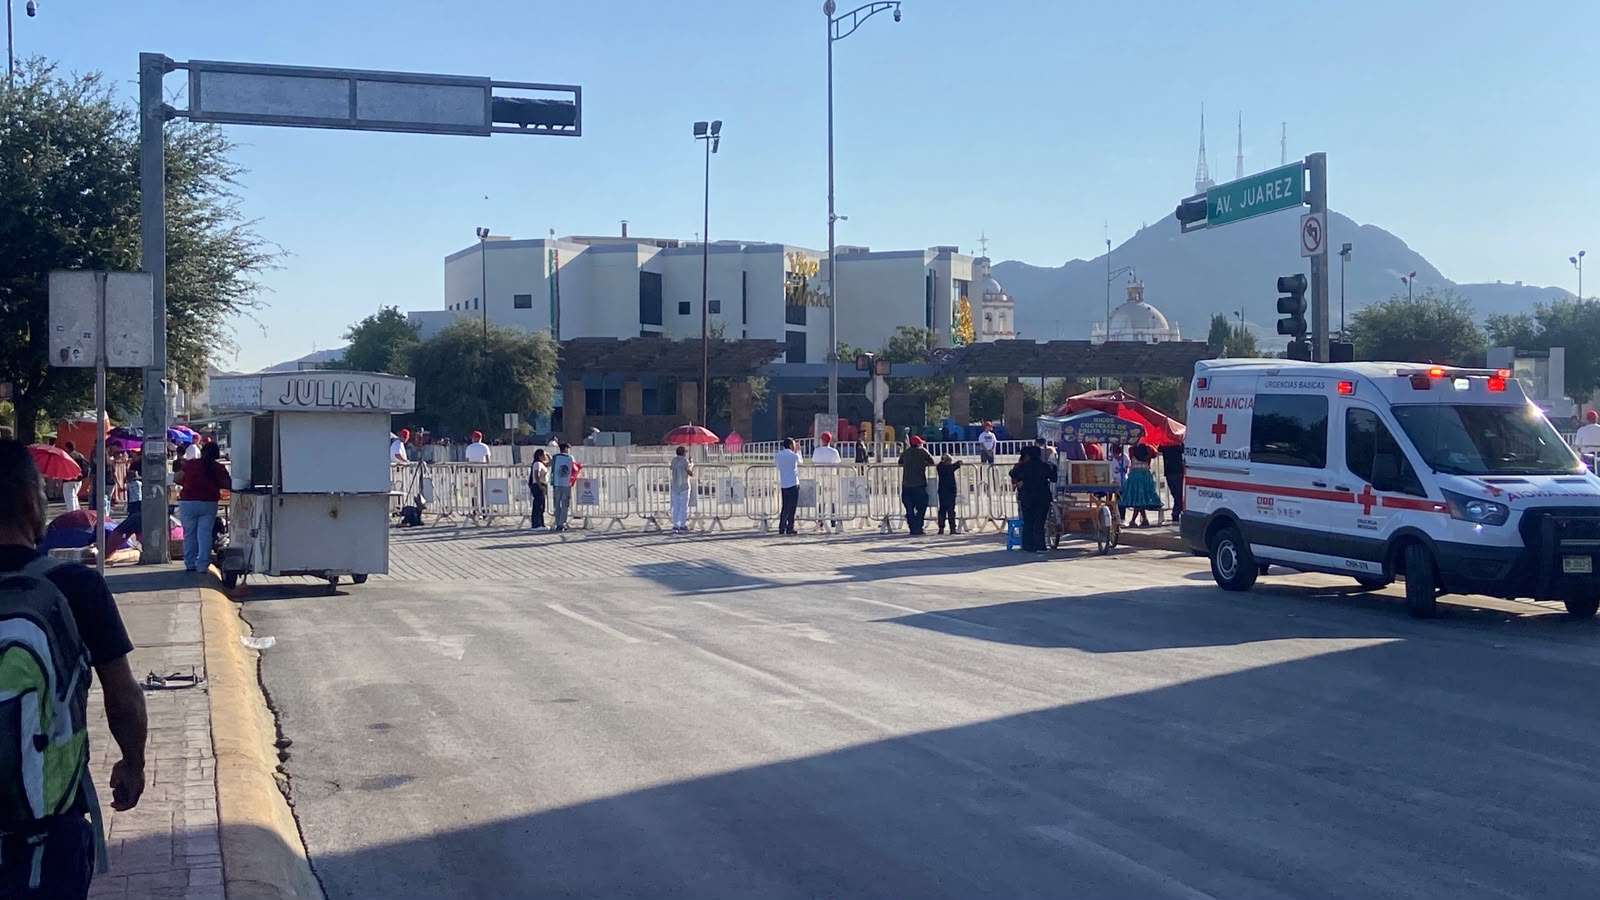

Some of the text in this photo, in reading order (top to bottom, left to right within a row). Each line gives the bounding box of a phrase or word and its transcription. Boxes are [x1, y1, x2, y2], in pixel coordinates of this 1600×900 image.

[1216, 177, 1293, 216] AV. JUAREZ
[279, 379, 381, 409] JULIAN
[1193, 396, 1255, 409] AMBULANCIA
[1184, 447, 1198, 457] CRUZ
[1200, 448, 1216, 459] ROJA
